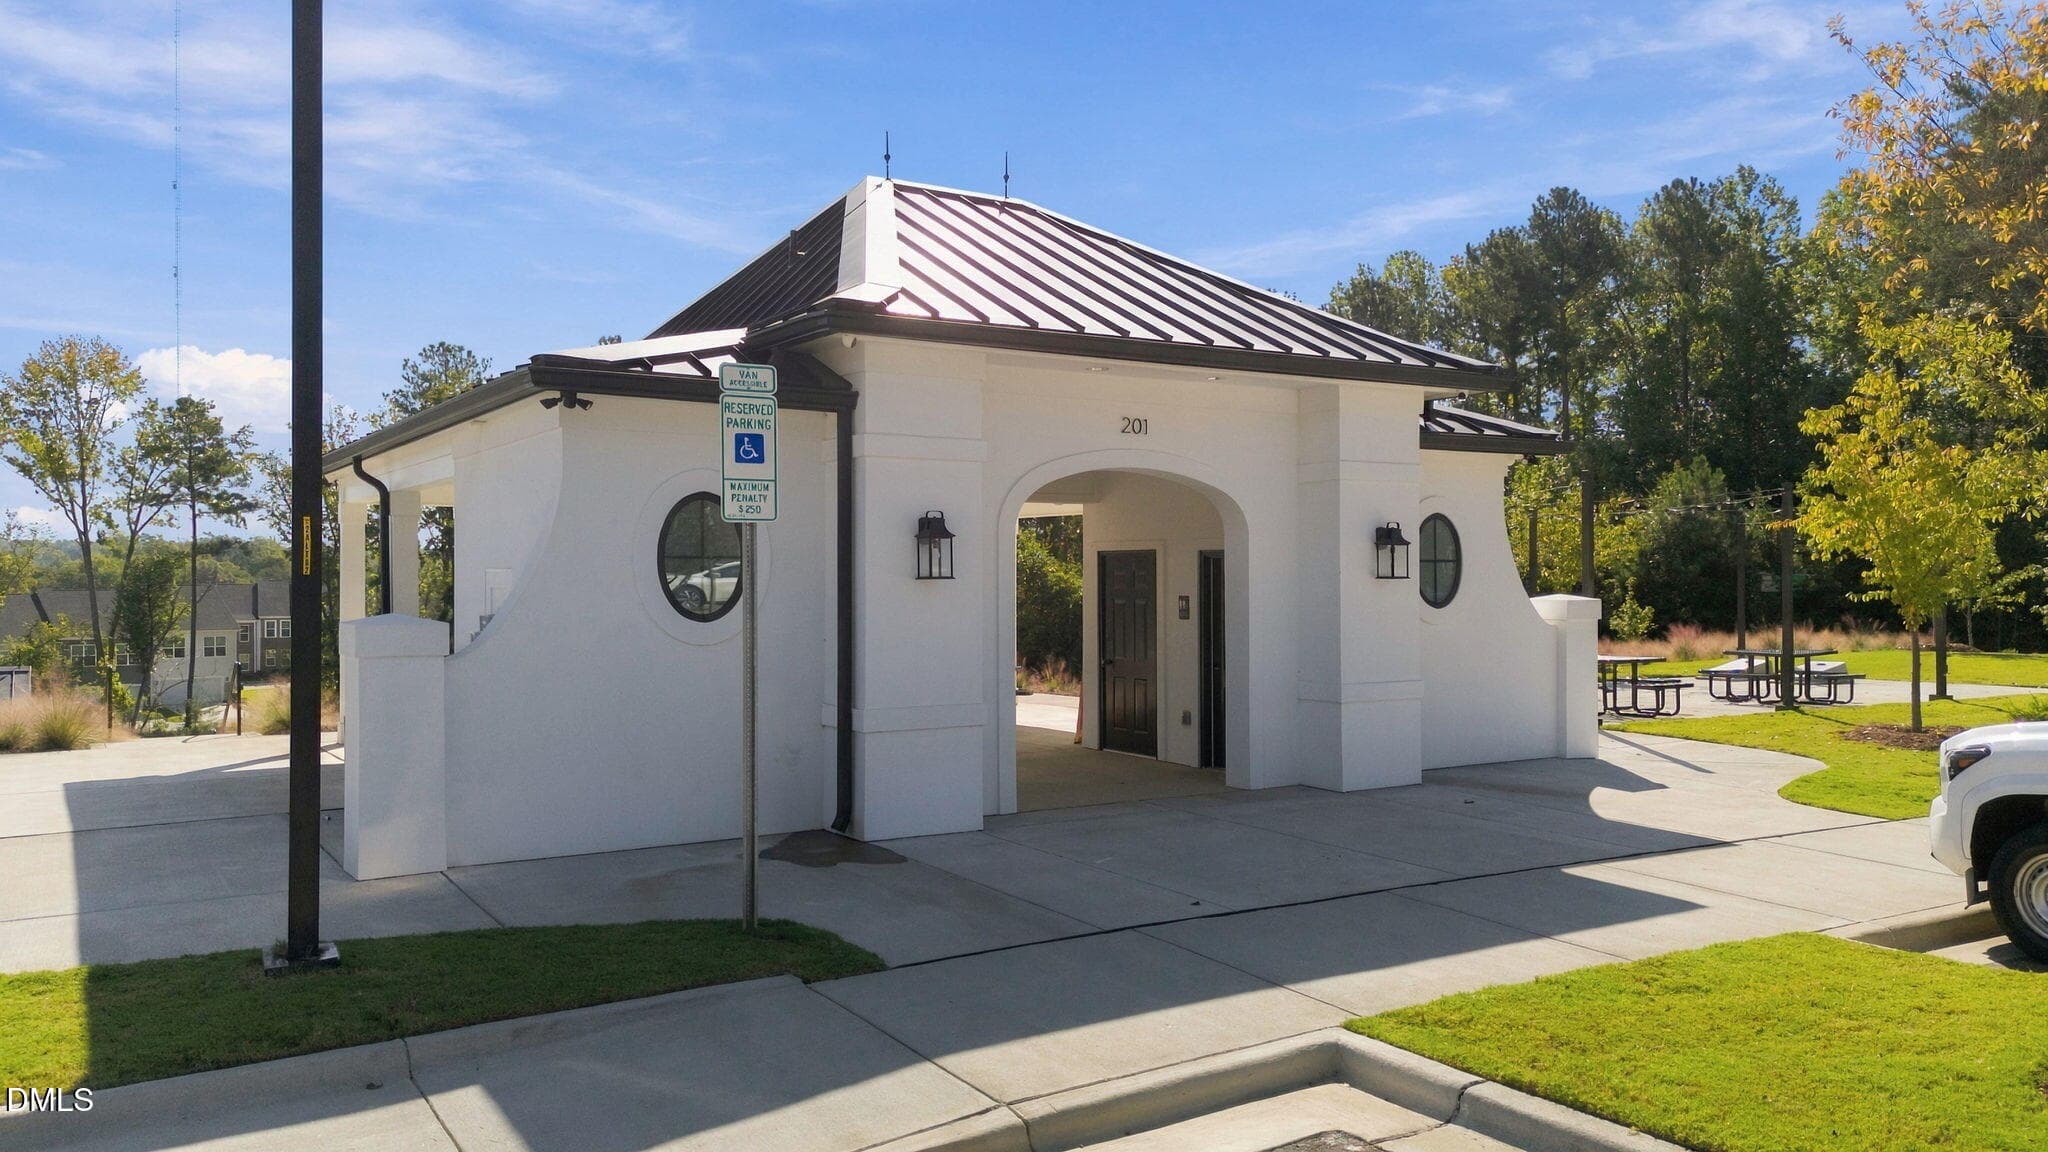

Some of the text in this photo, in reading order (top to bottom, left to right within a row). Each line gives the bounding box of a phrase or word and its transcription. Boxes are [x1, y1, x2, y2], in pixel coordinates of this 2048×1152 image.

[739, 370, 758, 379] VAN
[724, 401, 774, 415] RESERVED
[726, 417, 772, 430] PARKING
[1121, 416, 1148, 435] 201
[730, 482, 769, 491] MAXIMUM
[731, 494, 768, 503] PENALTY
